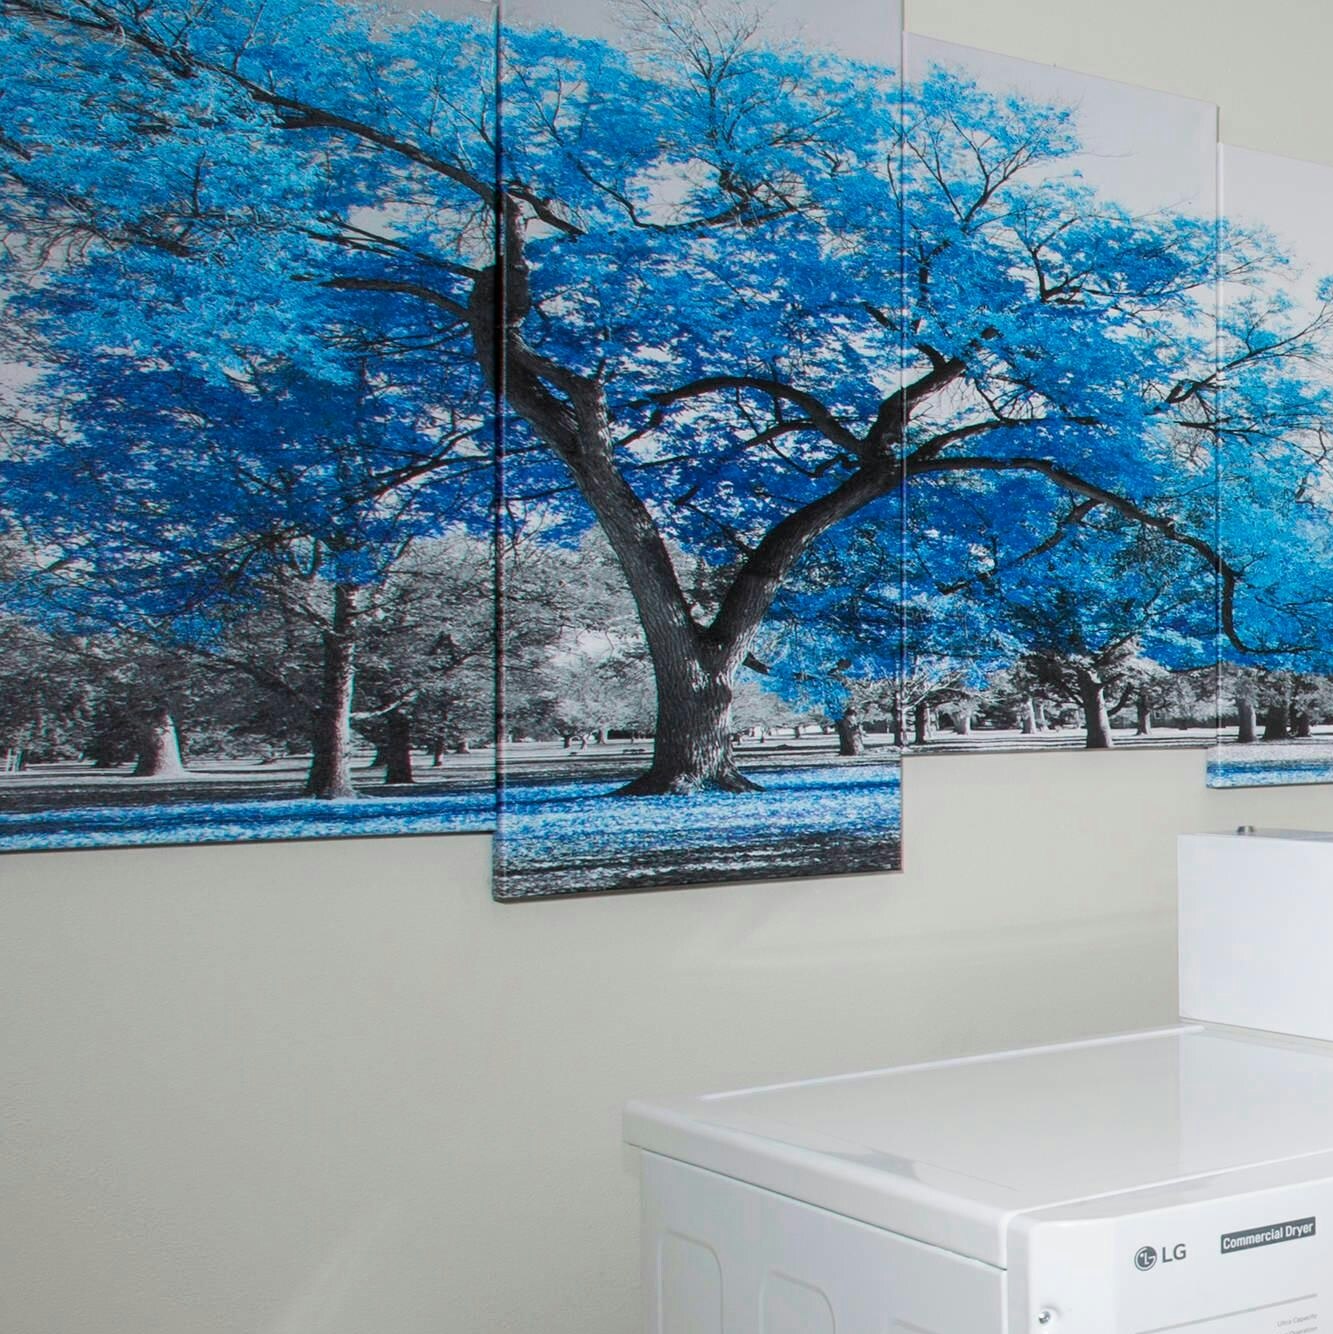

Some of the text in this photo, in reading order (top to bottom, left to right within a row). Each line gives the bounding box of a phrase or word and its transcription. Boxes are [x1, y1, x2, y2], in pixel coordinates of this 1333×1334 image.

[1222, 1221, 1314, 1250] Commercial Dryer
[1161, 1243, 1187, 1263] LG
